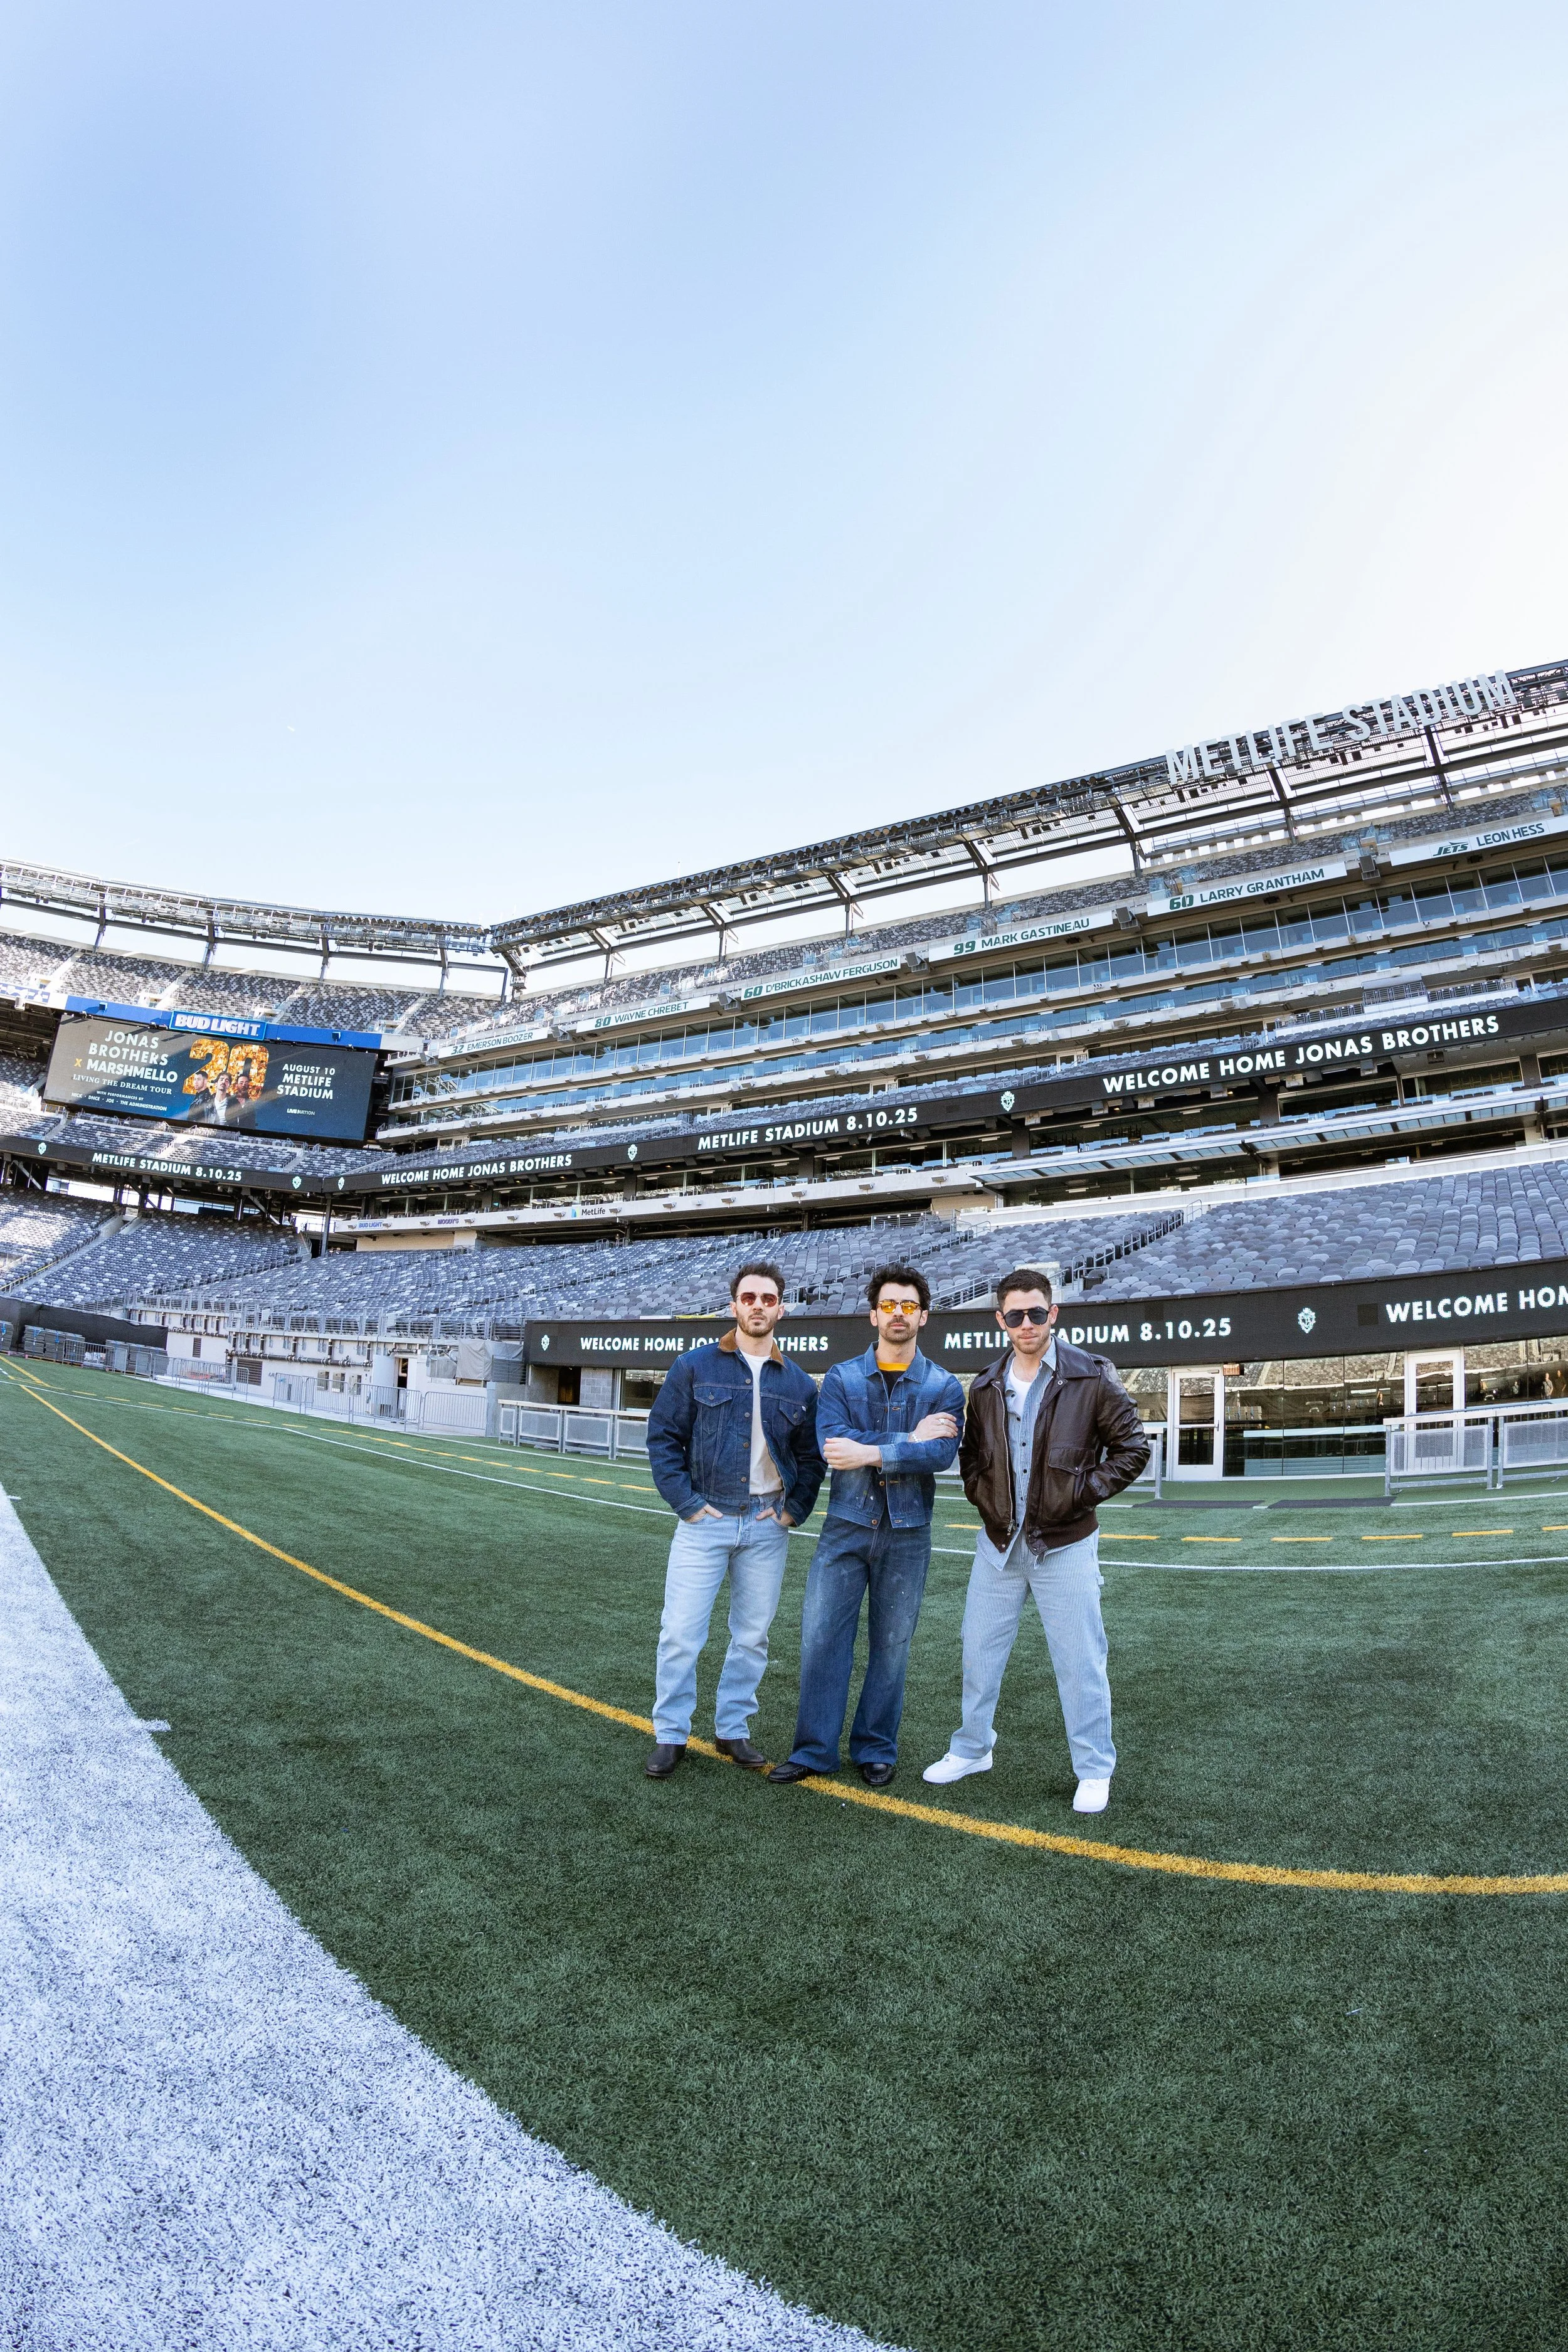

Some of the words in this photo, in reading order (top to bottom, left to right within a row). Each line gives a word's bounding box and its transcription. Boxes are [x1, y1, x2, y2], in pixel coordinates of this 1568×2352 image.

[1165, 712, 1334, 785] METLIFE
[1342, 669, 1518, 742] STADIUM
[1433, 841, 1469, 857] JETS
[1476, 830, 1510, 847] LEON
[1512, 823, 1545, 839] HESS
[1169, 894, 1194, 910] 60
[1199, 885, 1243, 903] LARRY
[1246, 868, 1325, 893] GRANTHAM
[954, 941, 976, 955] 99
[981, 932, 1019, 948] MARK
[1020, 918, 1090, 941] GASTINEAU
[744, 985, 763, 999] 60
[766, 970, 841, 995] D'BRICKASHAW
[843, 957, 898, 978] FERGUSON
[174, 1014, 210, 1030] BUD
[595, 1017, 611, 1028] 80
[614, 1010, 647, 1024] WAYNE
[648, 1002, 689, 1016] CHREBET
[105, 1030, 159, 1049] JONAS
[451, 1044, 464, 1055] 32
[467, 1037, 501, 1051] EMERSON
[502, 1032, 533, 1044] BOOZER
[88, 1042, 169, 1066] BROTHERS
[1103, 1062, 1210, 1094] WELCOME
[1219, 1050, 1286, 1076] HOME
[1295, 1036, 1373, 1065] JONAS
[1383, 1015, 1500, 1050] BROTHERS
[87, 1058, 178, 1083] MARSHMELLO
[183, 1039, 269, 1101] 20
[282, 1063, 320, 1074] AUGUST
[324, 1067, 336, 1076] 10
[282, 1073, 332, 1087] METLIFE
[73, 1074, 100, 1084] LIVING
[102, 1079, 118, 1087] THE
[120, 1081, 147, 1091] DREAM
[150, 1086, 172, 1095] TOUR
[107, 1092, 136, 1101] PERFORMANCES
[277, 1084, 333, 1099] STADIUM
[129, 1101, 167, 1111] ADMINISTRATION
[697, 1130, 758, 1150] METLIFE
[765, 1118, 839, 1142] STADIUM
[847, 1108, 918, 1131] 8.10.25
[92, 1153, 135, 1168] METLIFE
[139, 1159, 191, 1175] STADIUM
[196, 1167, 242, 1182] 8.10.25
[381, 1170, 429, 1185] WELCOME
[433, 1168, 464, 1180] HOME
[467, 1162, 506, 1177] JONAS
[509, 1154, 572, 1172] BROTHERS
[581, 1207, 606, 1216] MetLife
[1385, 1292, 1508, 1323] WELCOME
[580, 1337, 640, 1351] WELCOME
[644, 1337, 684, 1351] HOME
[944, 1331, 1011, 1349] METLIF
[1050, 1325, 1130, 1345] ADIUM
[1140, 1318, 1231, 1342] 8.10.25
